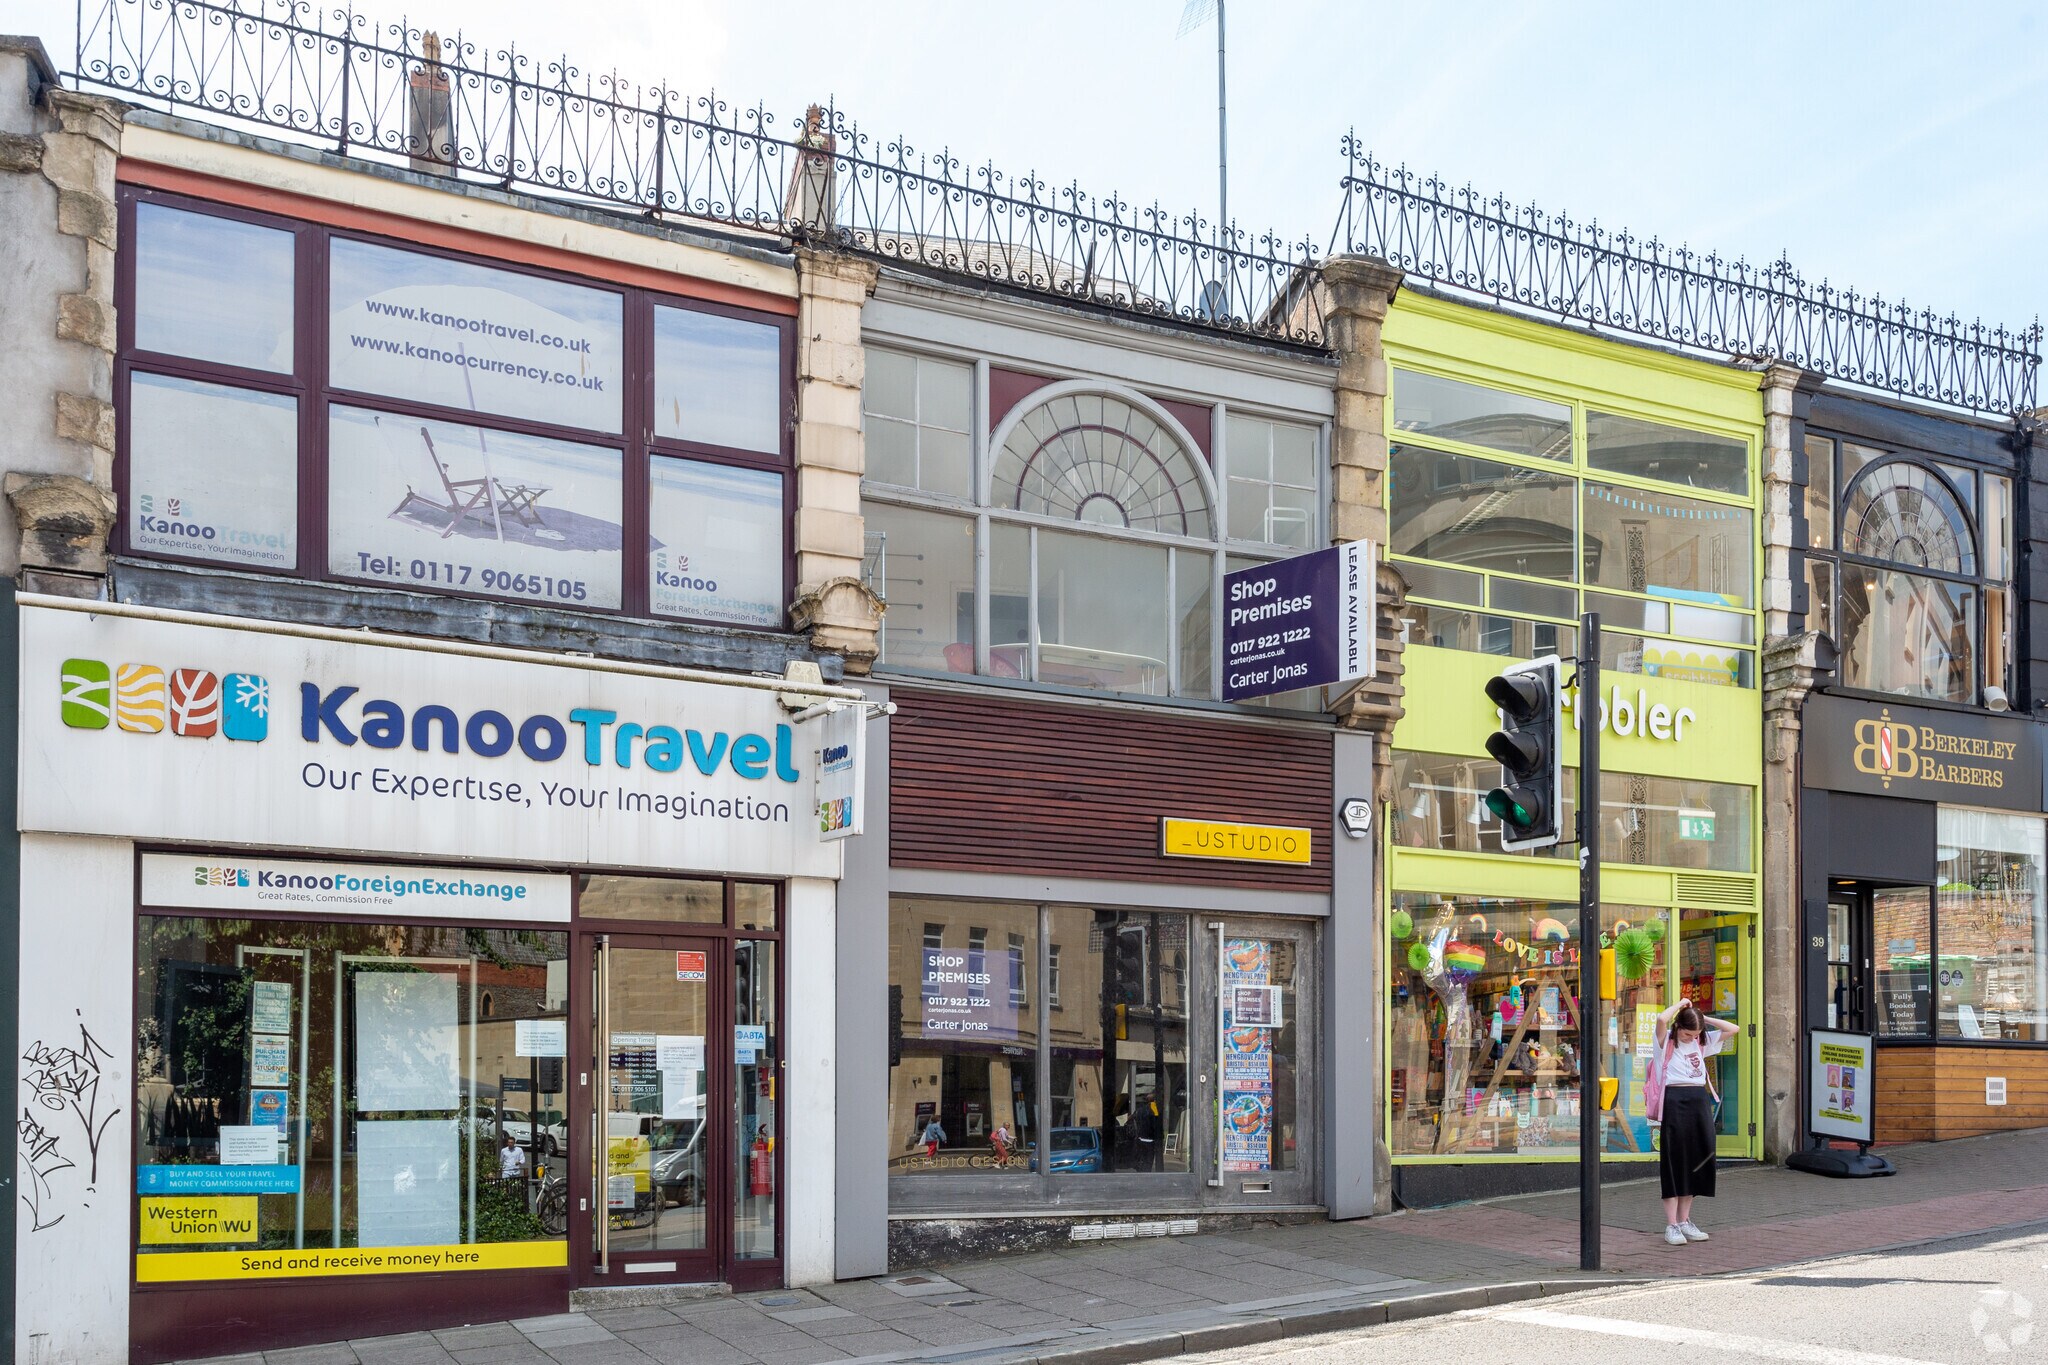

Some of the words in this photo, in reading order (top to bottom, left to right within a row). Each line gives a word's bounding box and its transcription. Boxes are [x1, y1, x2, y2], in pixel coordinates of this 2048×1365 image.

[365, 299, 592, 354] www.kanootravel.co.uk
[350, 334, 604, 392] www.kanoocurrency.co.uk
[139, 535, 157, 545] Our
[158, 537, 206, 552] Expertise,
[207, 543, 229, 555] Your
[229, 546, 286, 562] Imagination
[357, 551, 401, 577] Tel:
[410, 559, 472, 585] 0117
[480, 568, 588, 601] 9065105
[1348, 546, 1358, 592] LEASE
[656, 571, 717, 592] Kanoo
[1230, 578, 1277, 602] Shop
[656, 602, 677, 612] Great
[678, 605, 702, 616] Rates,
[703, 609, 750, 621] Commission
[751, 614, 768, 624] Free
[1230, 594, 1313, 627] Premises
[1230, 638, 1256, 655] 0117
[1257, 633, 1280, 649] 922
[1283, 626, 1311, 643] 1222
[1348, 595, 1358, 675] AVAILABLE
[1229, 648, 1286, 666] carterjonas.co.uk
[1229, 669, 1270, 689] Carter
[1271, 662, 1308, 685] Jonas
[1920, 726, 2017, 761] BERKELEY
[823, 744, 848, 764] Kanoo
[1920, 756, 2004, 789] BARBERS
[301, 762, 362, 791] Our
[372, 767, 532, 808] Expertise,
[540, 781, 609, 810] Your
[617, 786, 790, 823] Imagination
[257, 891, 283, 901] Great
[285, 892, 314, 903] Rates,
[316, 894, 372, 905] Commission
[374, 896, 393, 905] Free
[1493, 929, 1538, 963] LOVE
[1544, 950, 1564, 965] IS
[1812, 936, 1825, 947] 39
[928, 955, 964, 967] SHOP
[679, 971, 705, 979] SECOM
[928, 971, 991, 985] PREMISES
[928, 996, 948, 1005] 0117
[950, 997, 967, 1006] 922
[970, 998, 991, 1007] 1222
[1889, 1001, 1916, 1009] Booked
[1893, 993, 1912, 1004] Fully
[927, 1018, 960, 1030] Carter
[961, 1019, 988, 1032] Jonas
[1891, 1011, 1914, 1020] Today
[743, 1031, 765, 1040] ABTA
[1836, 1046, 1861, 1054] FAVOURITE
[899, 1156, 967, 1169] USTUDIO
[187, 1170, 204, 1178] AND
[248, 1170, 276, 1178] TRAVEL
[148, 1206, 218, 1219] Western
[171, 1220, 217, 1233] Union
[241, 1256, 283, 1271] Send
[287, 1255, 319, 1269] and
[324, 1253, 382, 1267] receive
[387, 1252, 441, 1267] money
[445, 1250, 480, 1263] here
